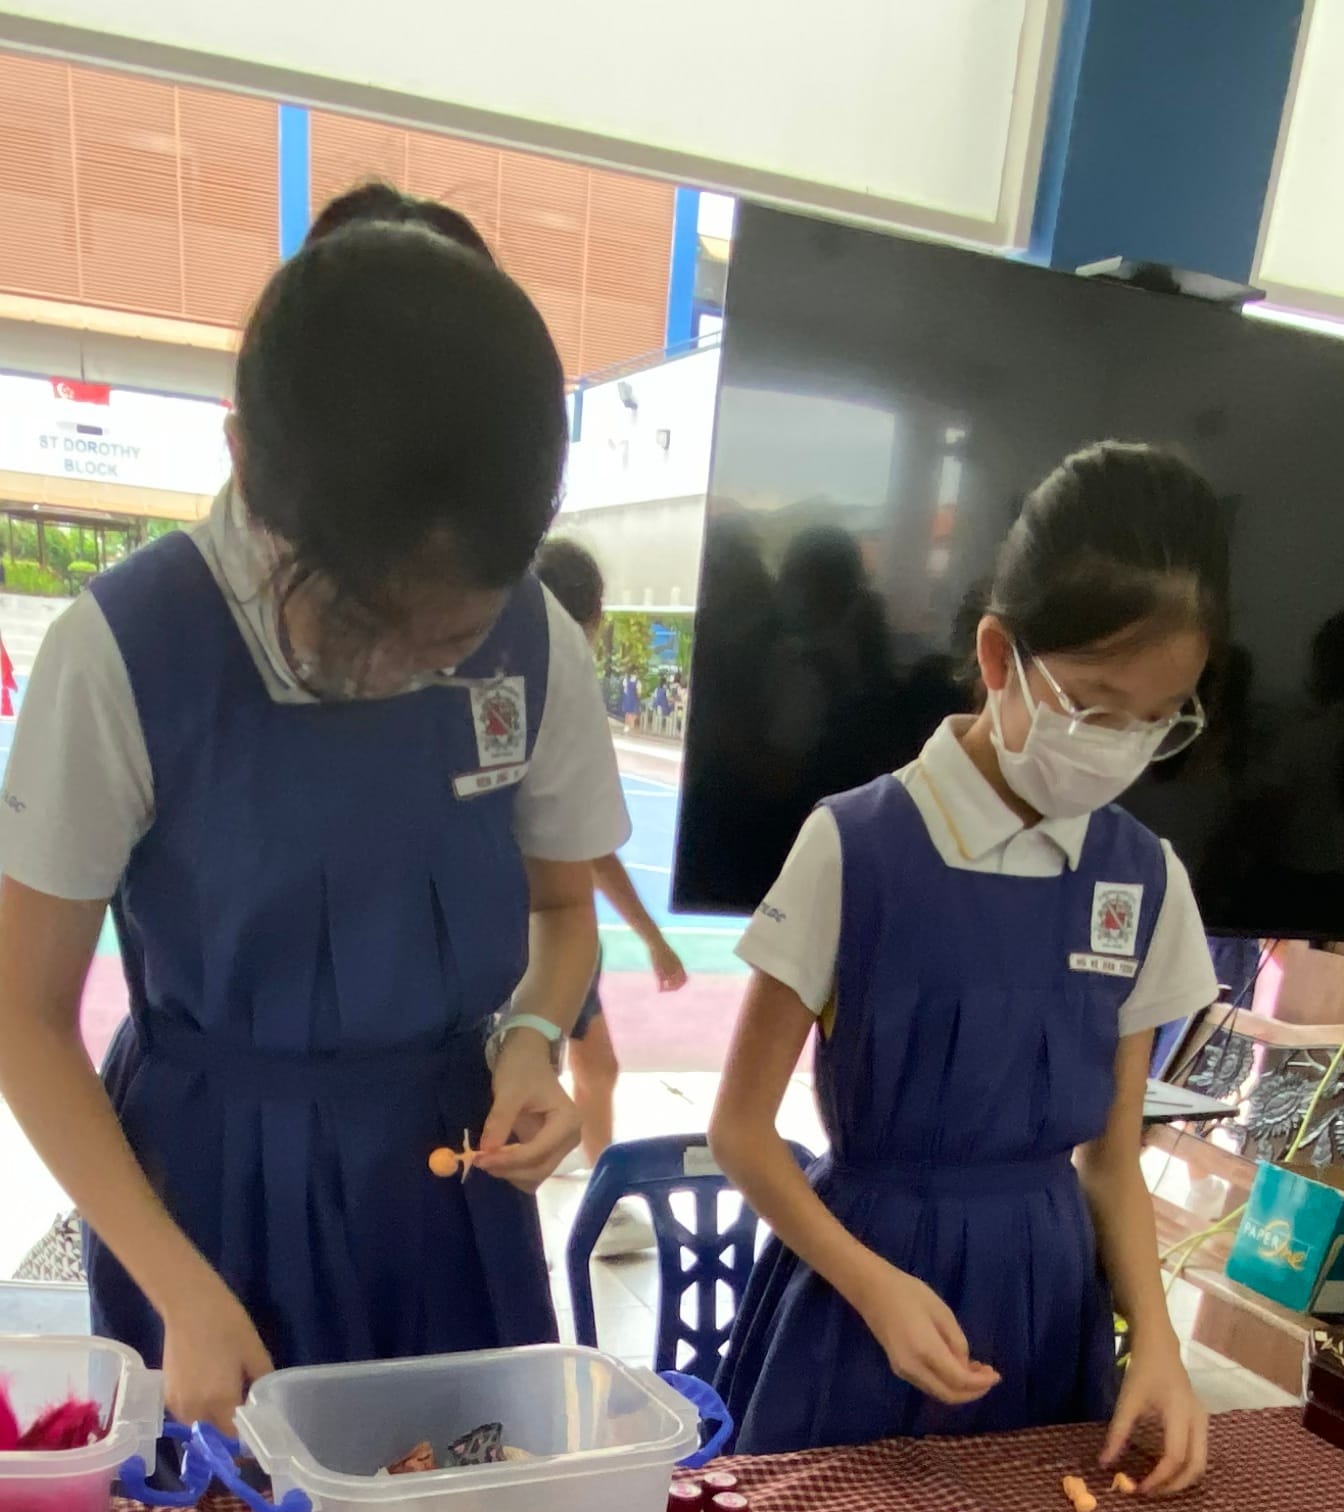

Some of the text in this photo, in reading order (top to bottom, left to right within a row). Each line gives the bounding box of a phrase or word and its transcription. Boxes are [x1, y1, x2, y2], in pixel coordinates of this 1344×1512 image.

[39, 435, 141, 459] ST DOROTHY
[63, 458, 118, 476] BLOCK
